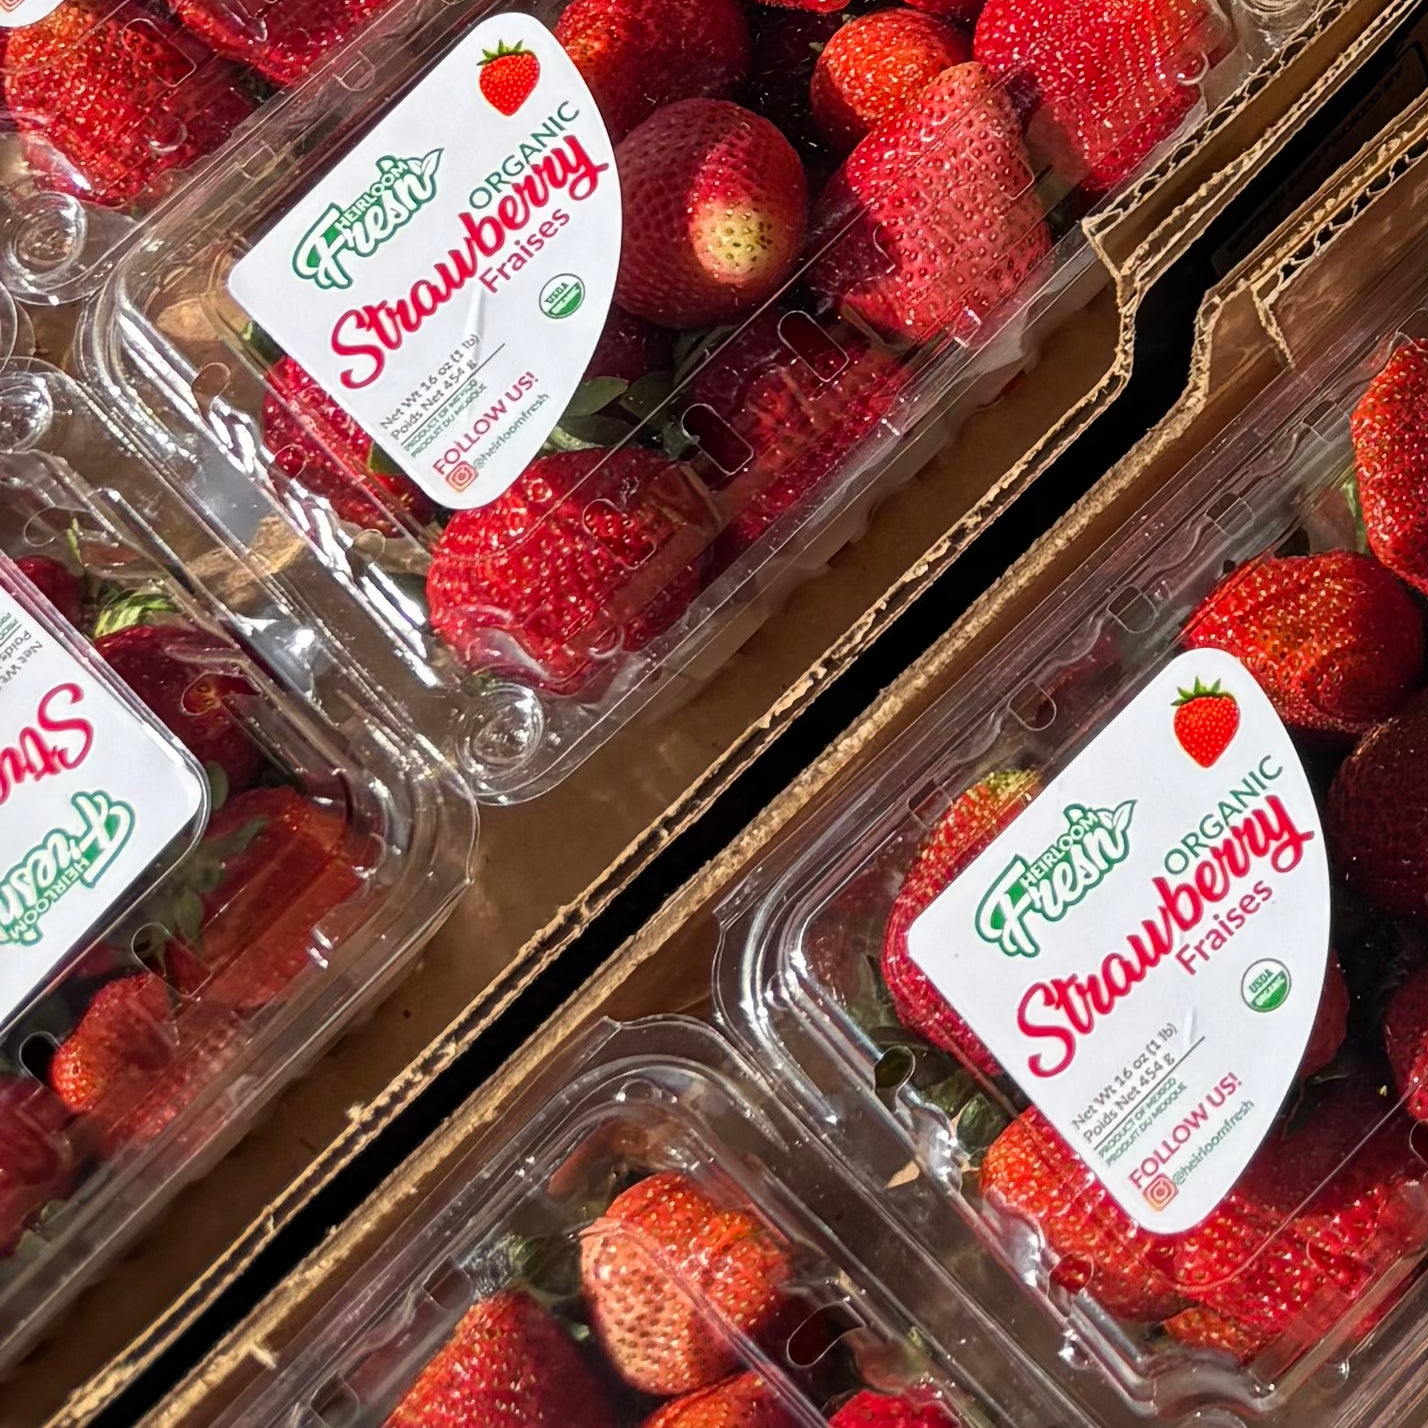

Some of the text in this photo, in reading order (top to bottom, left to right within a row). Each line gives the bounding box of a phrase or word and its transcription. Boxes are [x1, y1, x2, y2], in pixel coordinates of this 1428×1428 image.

[469, 101, 581, 209] ORGANIC
[295, 154, 437, 291] Fresh
[331, 135, 608, 389] Strawberry
[477, 208, 569, 294] Fraises
[432, 370, 539, 476] FOLLOW US!
[1019, 809, 1100, 888] HEIRLOOM
[1164, 755, 1284, 874] ORGANIC
[7, 858, 90, 941] HEIRLOOM
[977, 802, 1130, 960] Fresh
[1174, 880, 1272, 976] Fraises
[1017, 795, 1313, 1078] Strawberry
[1070, 1020, 1180, 1130] Net Wt 16 oz (1 lb)
[1081, 1108, 1119, 1144] Poids
[1114, 1084, 1142, 1112] Net
[1136, 1059, 1166, 1089] 454
[1127, 1070, 1243, 1190] FOLLOW US!
[1171, 1099, 1256, 1185] @heirloomfresh
